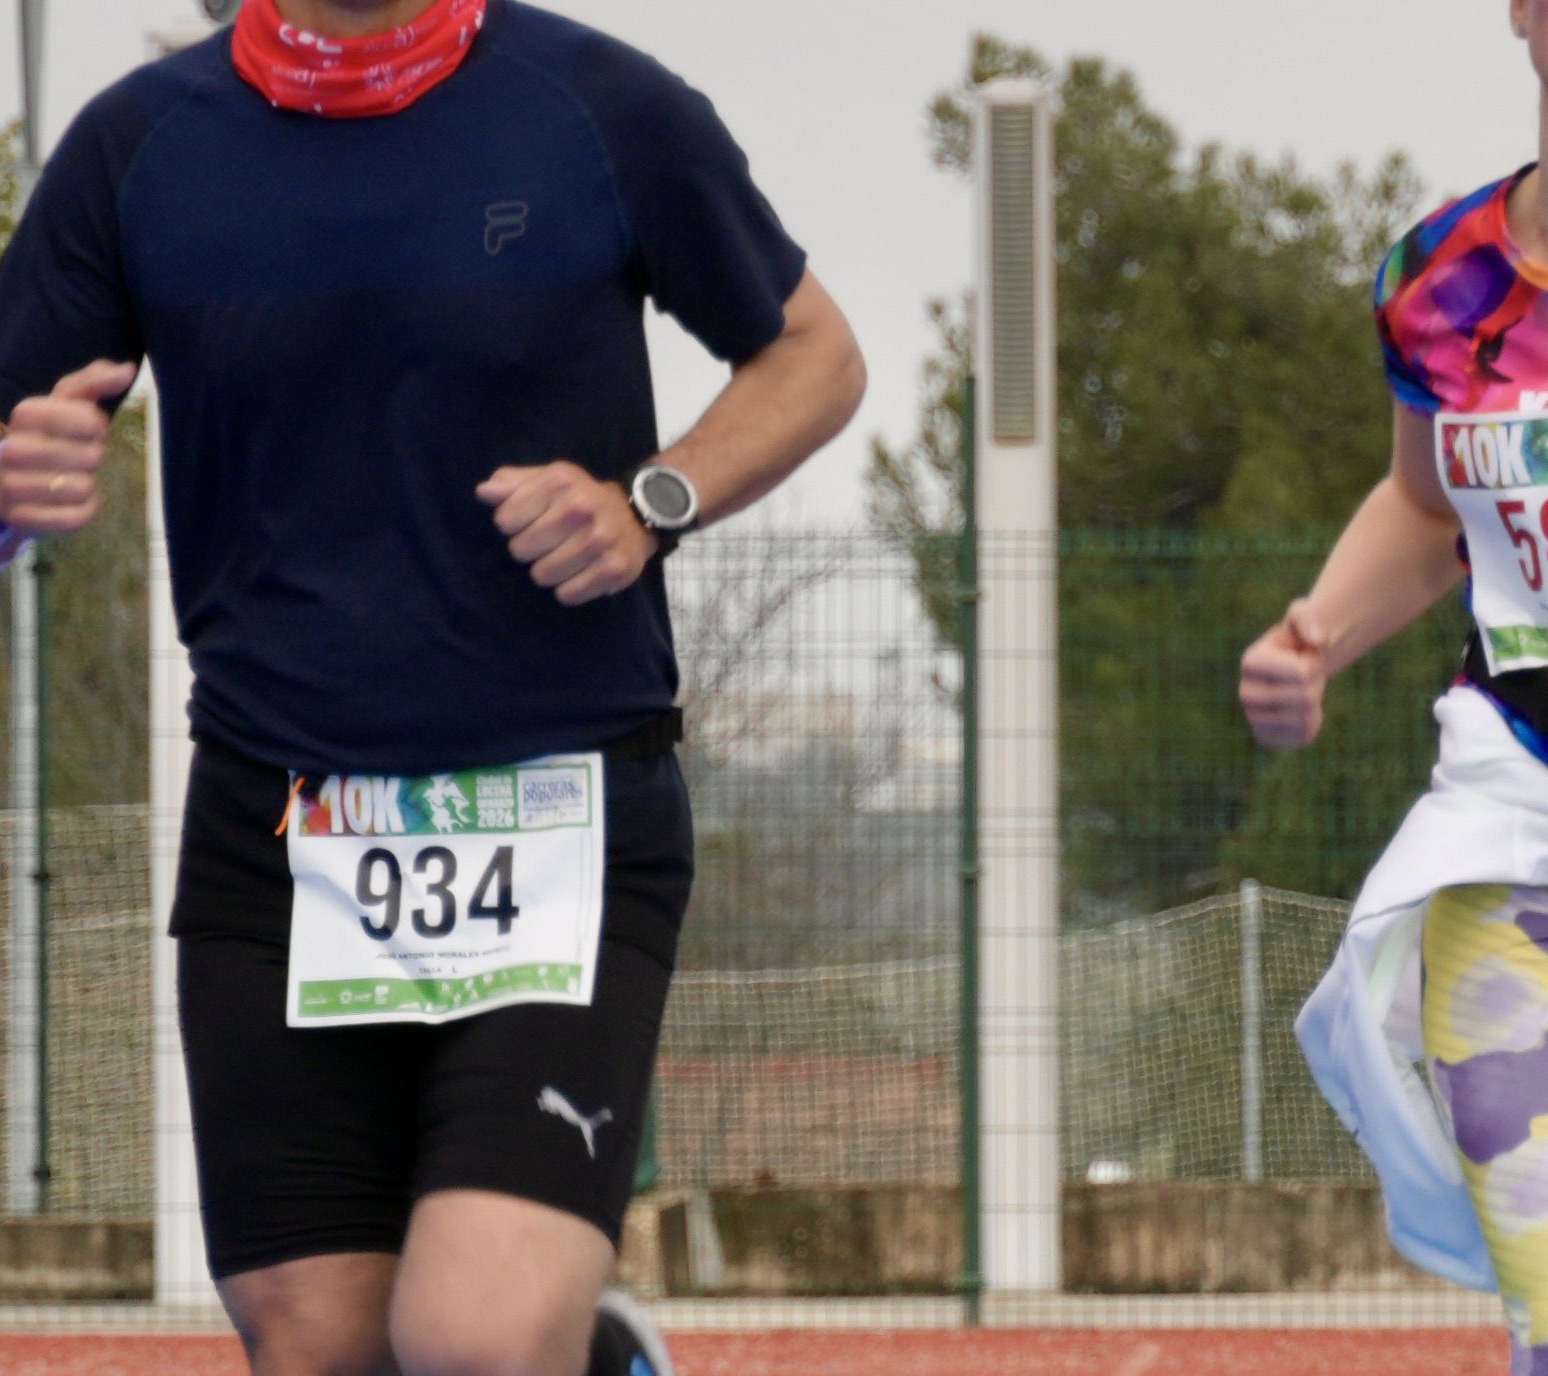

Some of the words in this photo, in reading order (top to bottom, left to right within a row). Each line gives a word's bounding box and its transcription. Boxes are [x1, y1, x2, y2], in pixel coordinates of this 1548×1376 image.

[1455, 424, 1534, 488] 10K
[320, 775, 407, 834] 10K
[477, 808, 515, 828] 2026
[354, 845, 520, 941] 934
